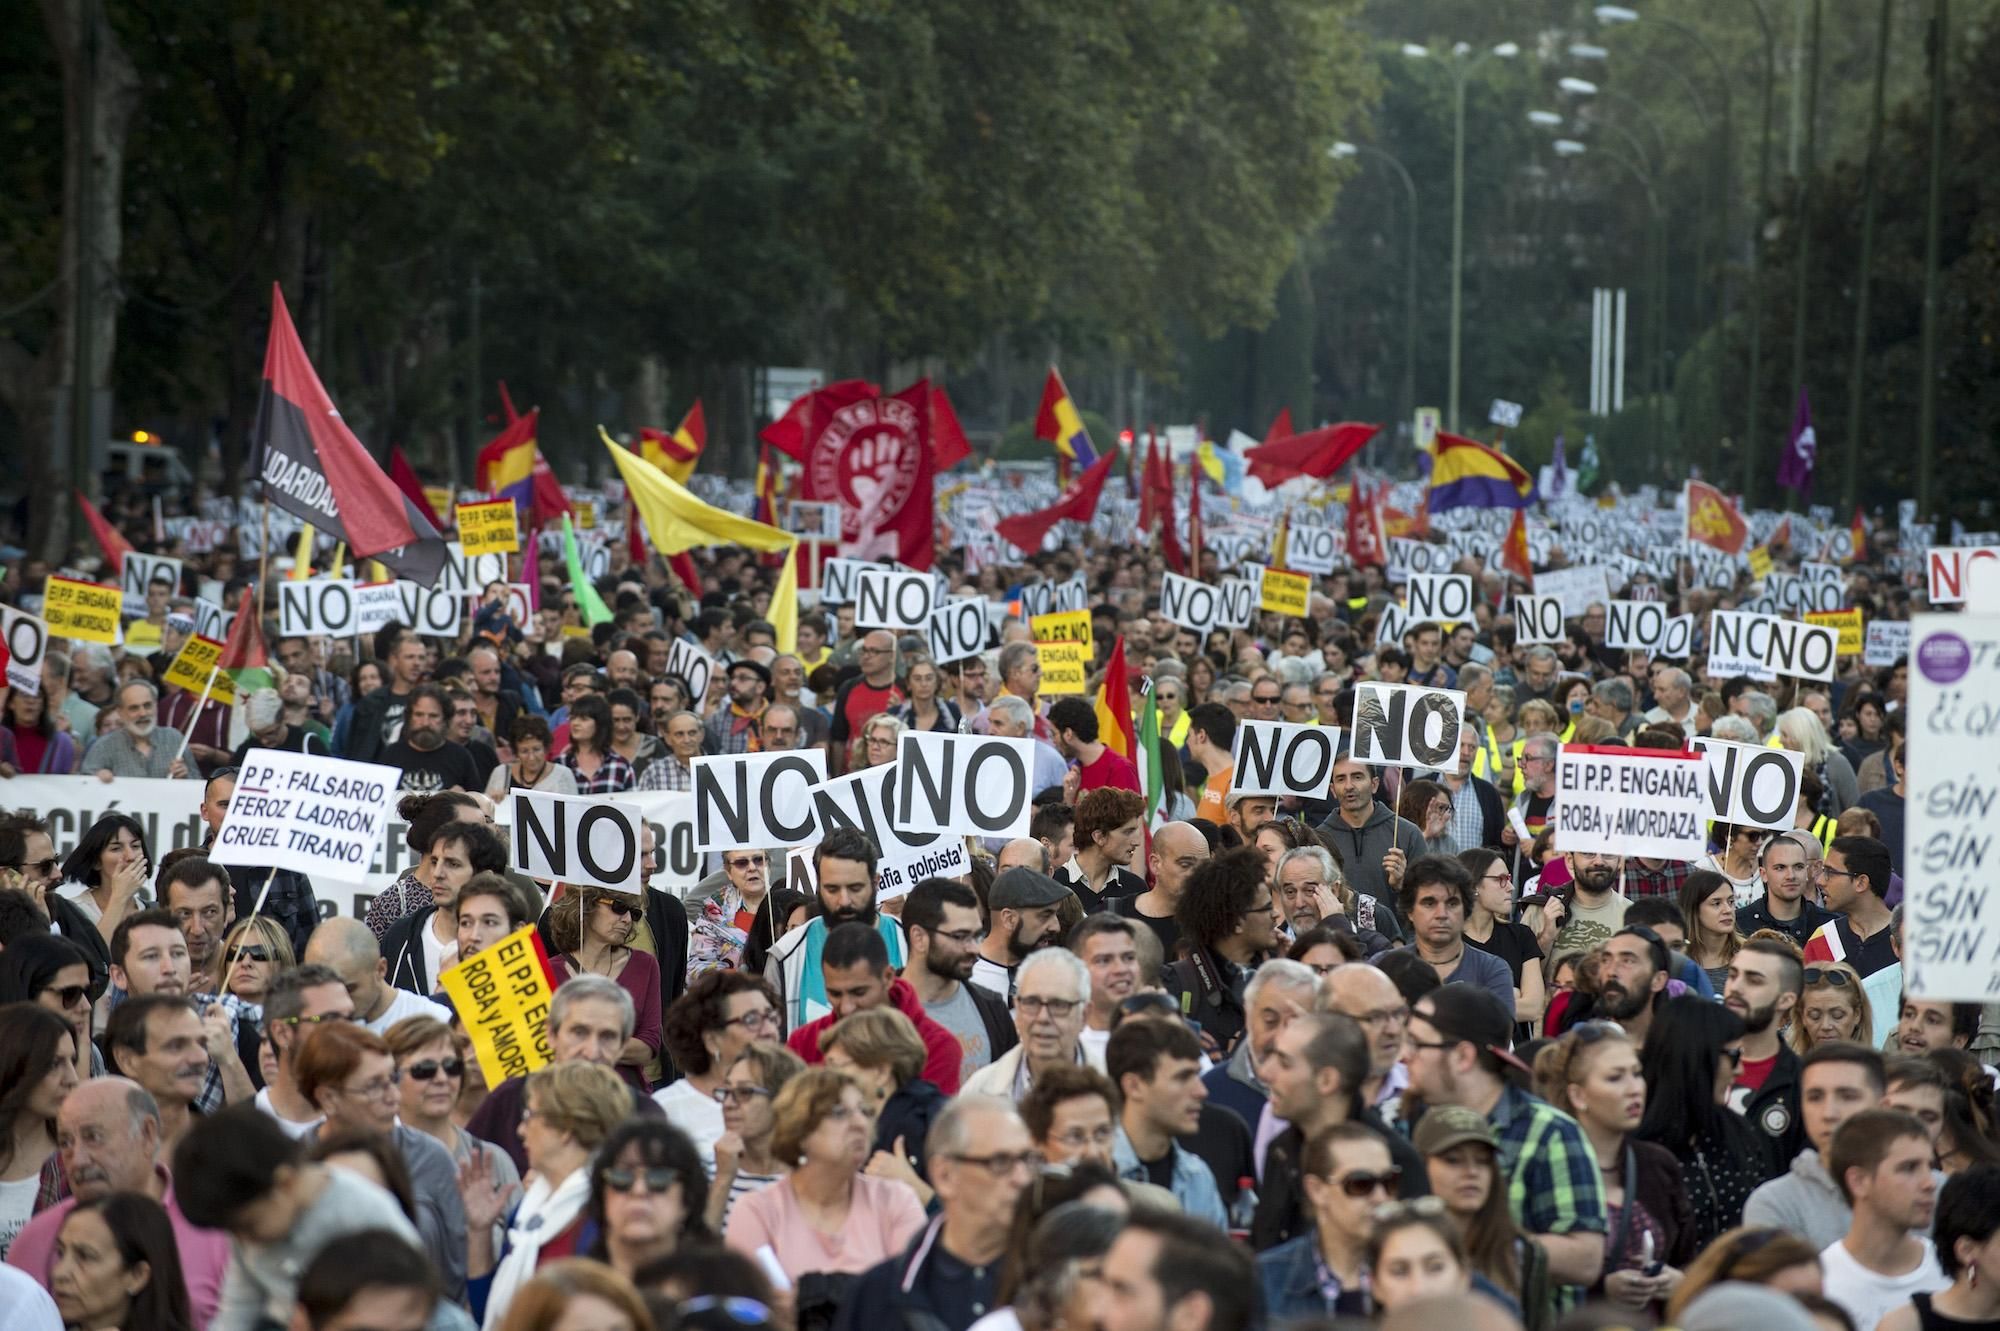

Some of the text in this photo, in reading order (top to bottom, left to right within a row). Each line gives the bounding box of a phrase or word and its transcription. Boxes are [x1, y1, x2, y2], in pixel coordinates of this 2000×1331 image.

[1293, 529, 1333, 559] NO
[1565, 521, 1597, 544] NO
[125, 556, 177, 596] NO
[445, 542, 504, 590] NO
[1391, 540, 1431, 573] NO
[1931, 549, 1998, 598] N
[284, 584, 350, 631] NO
[400, 585, 456, 630] NO
[859, 575, 929, 625] NO
[1022, 583, 1051, 616] NO
[1058, 581, 1087, 611] NO
[1163, 577, 1213, 626] NO
[1218, 583, 1251, 624] NO
[1409, 578, 1467, 618] NO
[1801, 584, 1840, 613] NO
[0, 608, 41, 667] O
[930, 603, 981, 659] NO
[1517, 598, 1561, 639] NO
[1608, 604, 1662, 645] NO
[1665, 619, 1688, 653] O
[1714, 615, 1768, 659] NO
[1765, 622, 1832, 675] NO
[669, 641, 708, 704] NO
[1354, 686, 1459, 767] NO
[1234, 725, 1331, 793] NO
[287, 769, 386, 808] FALSARIO,
[696, 756, 820, 846] NO
[899, 736, 1026, 831] NO
[1620, 764, 1704, 804] ENGAÑA,
[1694, 742, 1796, 824] NO
[232, 795, 375, 838] FEROZ LADRÓN,
[1561, 803, 1702, 841] ROBA y AMORDAZA.
[223, 824, 280, 849] CRUEL
[287, 830, 364, 865] TIRANO.
[515, 795, 636, 884] NO
[878, 866, 903, 891] afia
[461, 959, 501, 1014] ROBA
